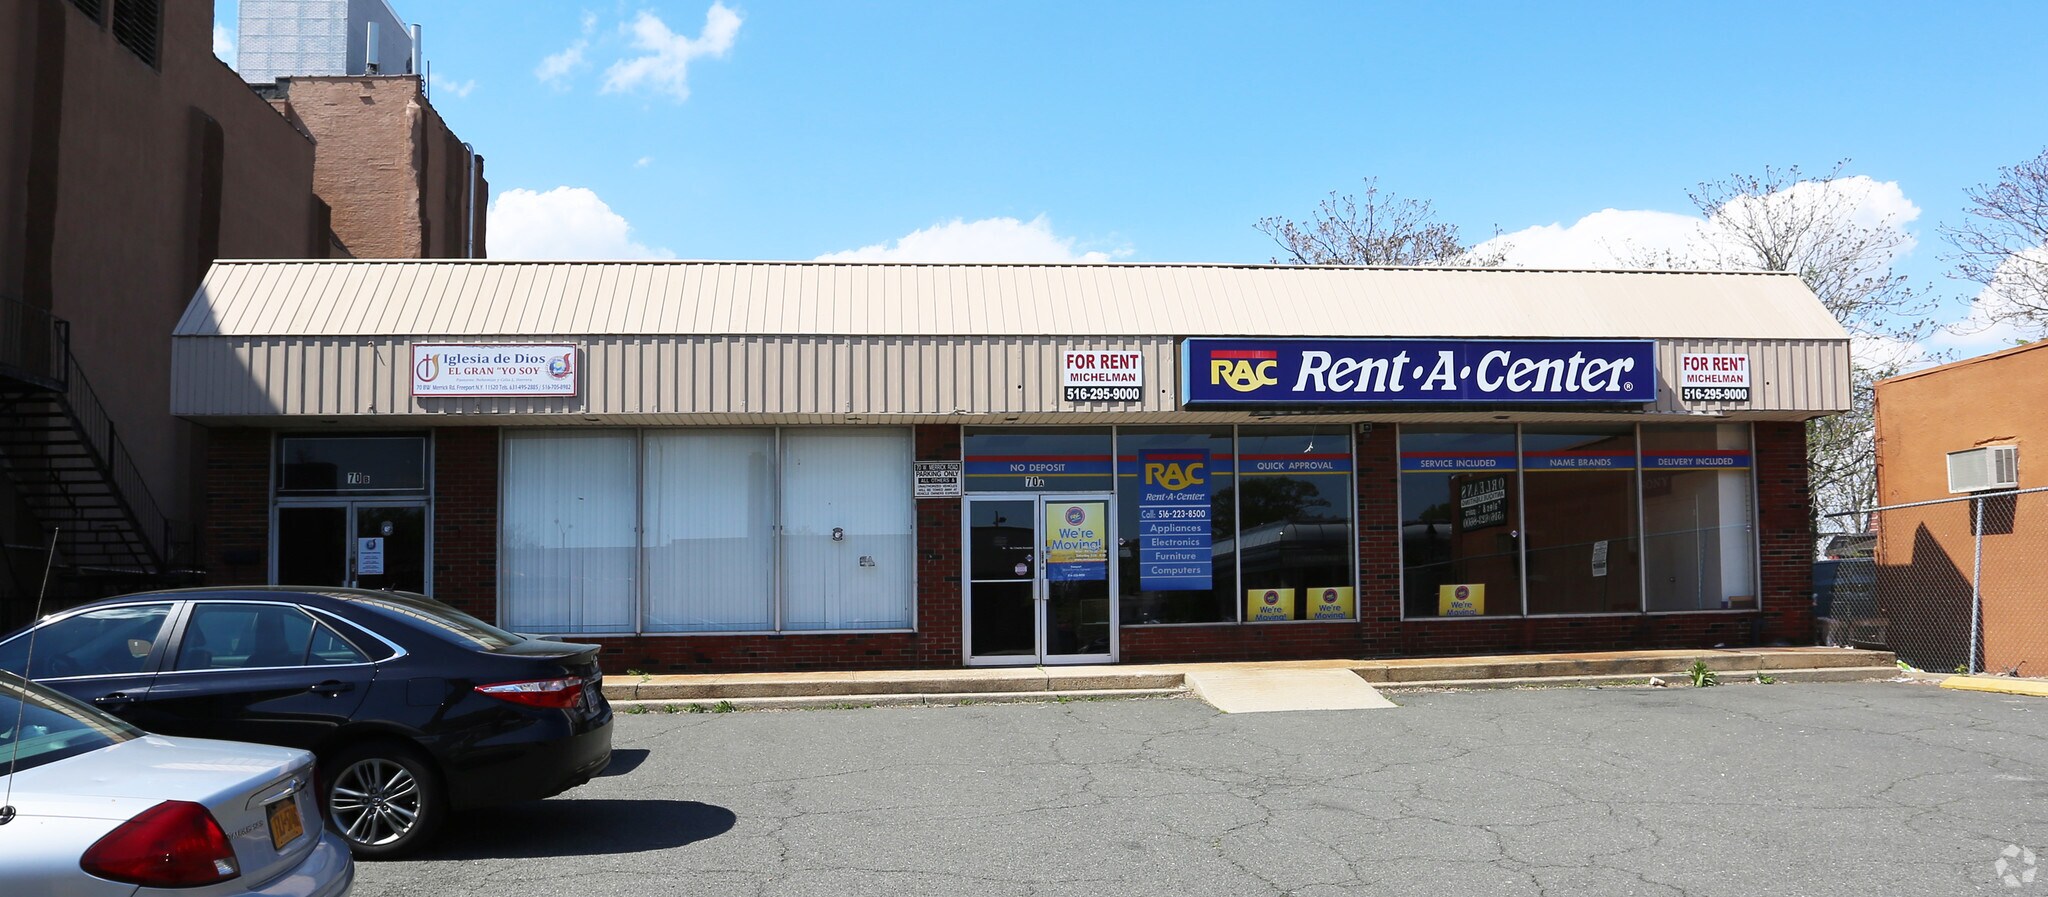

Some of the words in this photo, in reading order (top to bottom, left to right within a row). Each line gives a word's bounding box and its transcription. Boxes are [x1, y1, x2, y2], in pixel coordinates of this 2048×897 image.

[444, 354, 489, 366] Iglesia
[494, 353, 510, 364] de
[515, 353, 546, 364] Dios
[1066, 354, 1096, 369] FOR
[1100, 354, 1138, 369] RENT
[1684, 356, 1708, 371] FOR
[1713, 357, 1745, 371] RENT
[448, 367, 461, 375] EL
[464, 367, 494, 375] GRAN
[519, 367, 540, 375] SOY
[1070, 373, 1136, 382] MICHELMAN
[1211, 360, 1278, 392] RAC
[1687, 374, 1743, 382] MICHELMAN
[1067, 388, 1140, 400] 516-295-9000
[1684, 388, 1747, 400] 516-295-9000
[1257, 462, 1284, 470] QUICK
[1456, 459, 1496, 467] INCLUDED
[1658, 458, 1693, 466] DELIVERY
[1010, 464, 1025, 472] NO
[1145, 463, 1204, 490] RAC
[1141, 510, 1156, 519] Call:
[1158, 510, 1206, 518] 516-223-8500
[1059, 528, 1094, 538] We're
[1150, 524, 1201, 534] Appliances
[1052, 539, 1101, 551] Moving!
[1152, 538, 1200, 546] Electronics
[1155, 552, 1196, 560] Furniture
[1152, 566, 1200, 575] Computers
